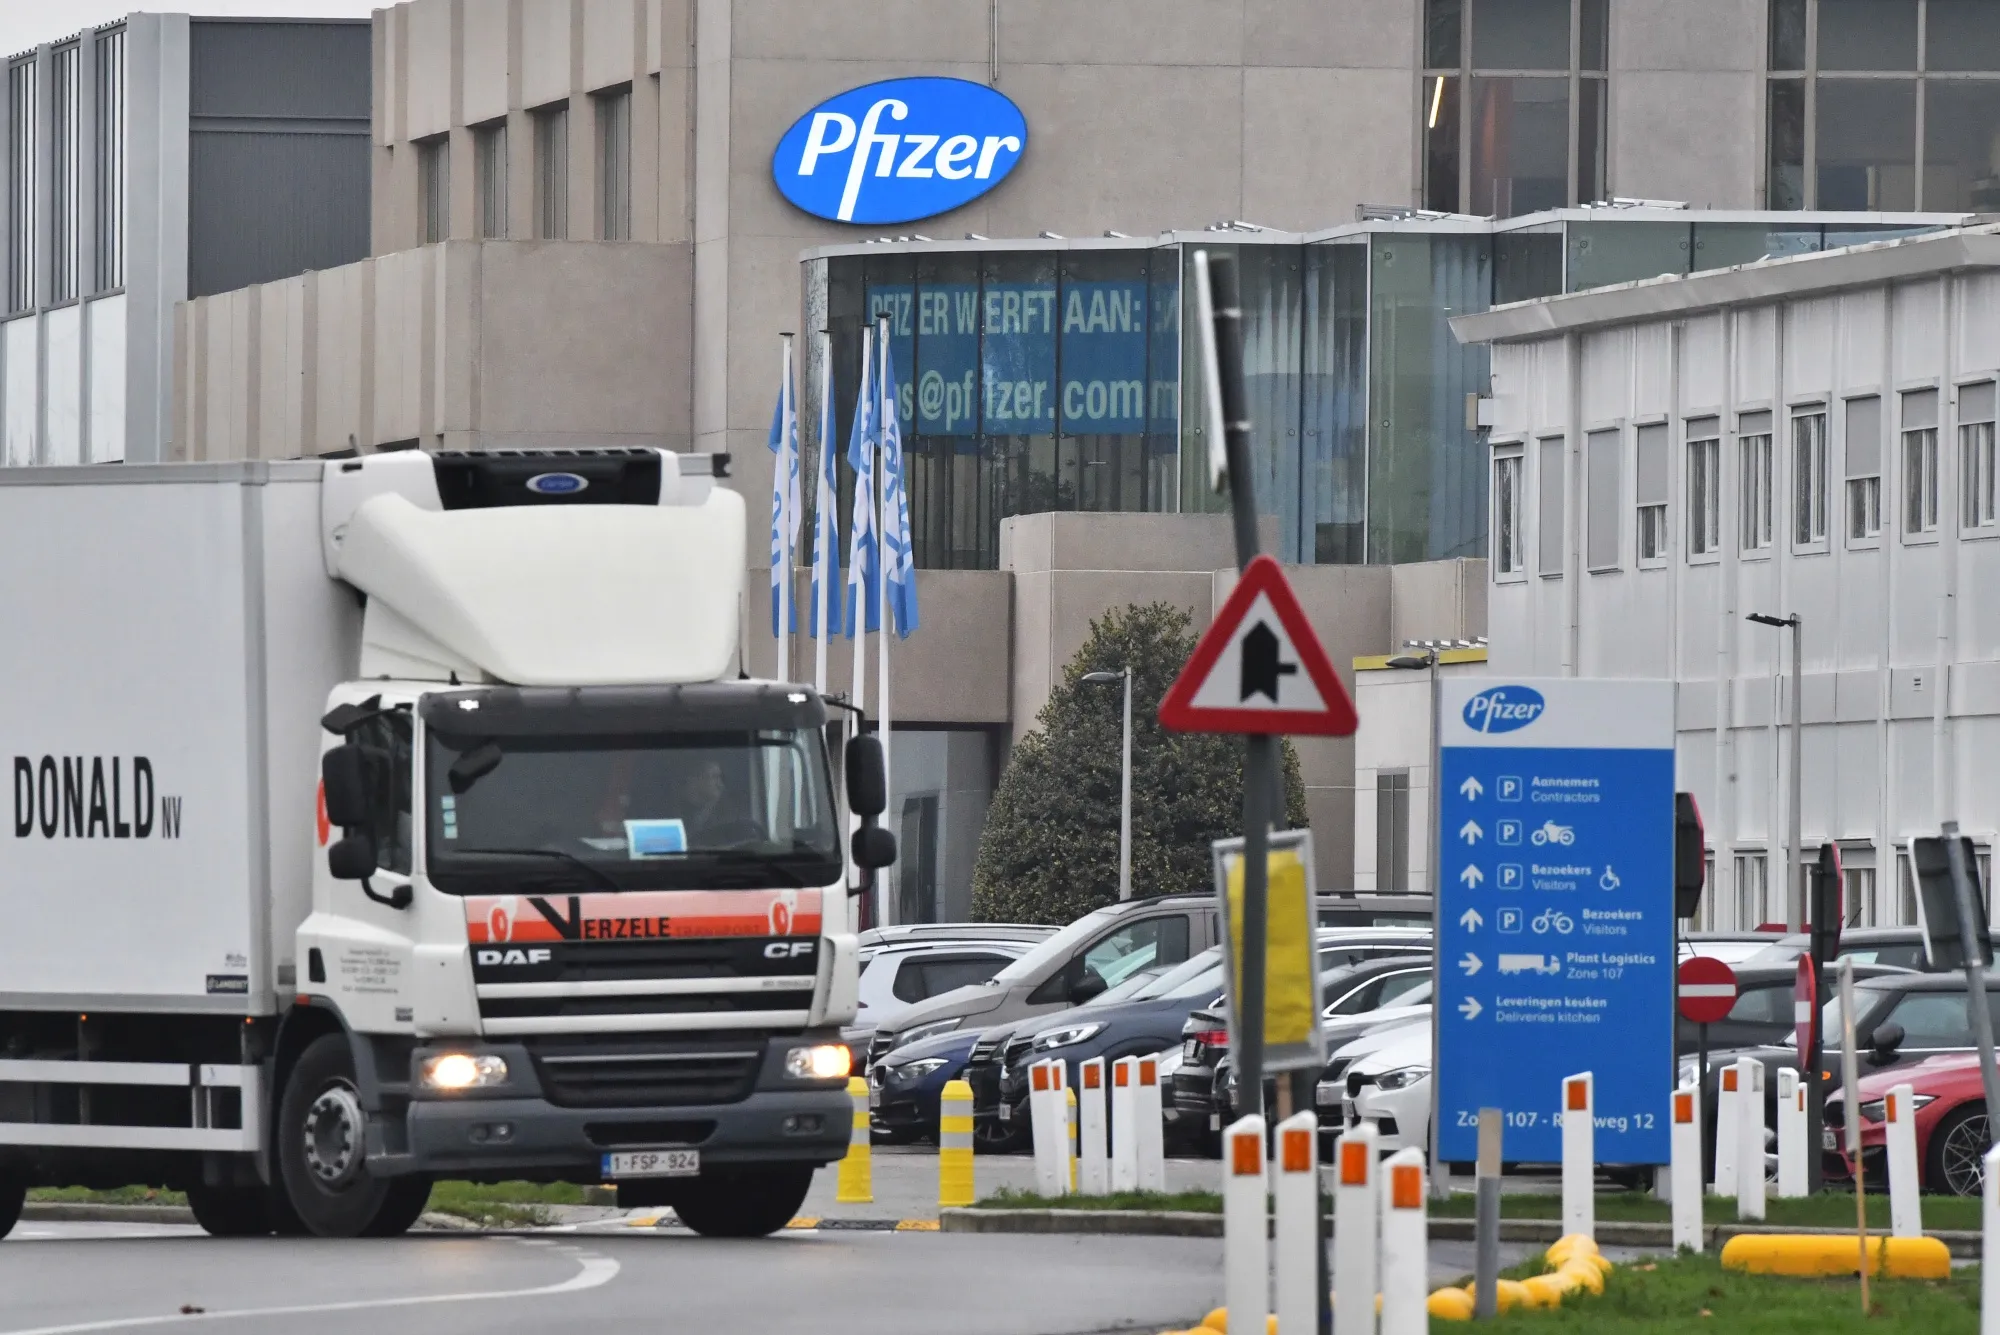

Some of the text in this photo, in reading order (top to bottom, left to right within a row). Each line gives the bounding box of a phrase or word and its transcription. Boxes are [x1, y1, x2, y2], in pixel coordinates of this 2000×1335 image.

[798, 98, 1020, 221] Pfizer
[955, 291, 1056, 335] WERFT
[1063, 289, 1141, 333] AAN:
[1469, 692, 1542, 733] Pfizer
[1531, 776, 1600, 788] Aannemers
[14, 755, 182, 838] DONALD NV
[1531, 791, 1600, 803] Contractors
[1531, 864, 1592, 876] Bezoekers
[1532, 879, 1577, 891] Visitors
[526, 896, 671, 940] VERZELE
[1582, 908, 1643, 920] Bezoekers
[1583, 923, 1628, 935] Visitors
[477, 948, 552, 966] DAF
[763, 942, 814, 960] CF
[1566, 952, 1656, 966] Plant Logistics
[1566, 967, 1624, 979] Zone 107
[1496, 996, 1607, 1010] Leveringen keuken
[1496, 1011, 1601, 1023] Deliveries kitchen
[1506, 1112, 1538, 1127] 107
[1634, 1114, 1655, 1129] 12
